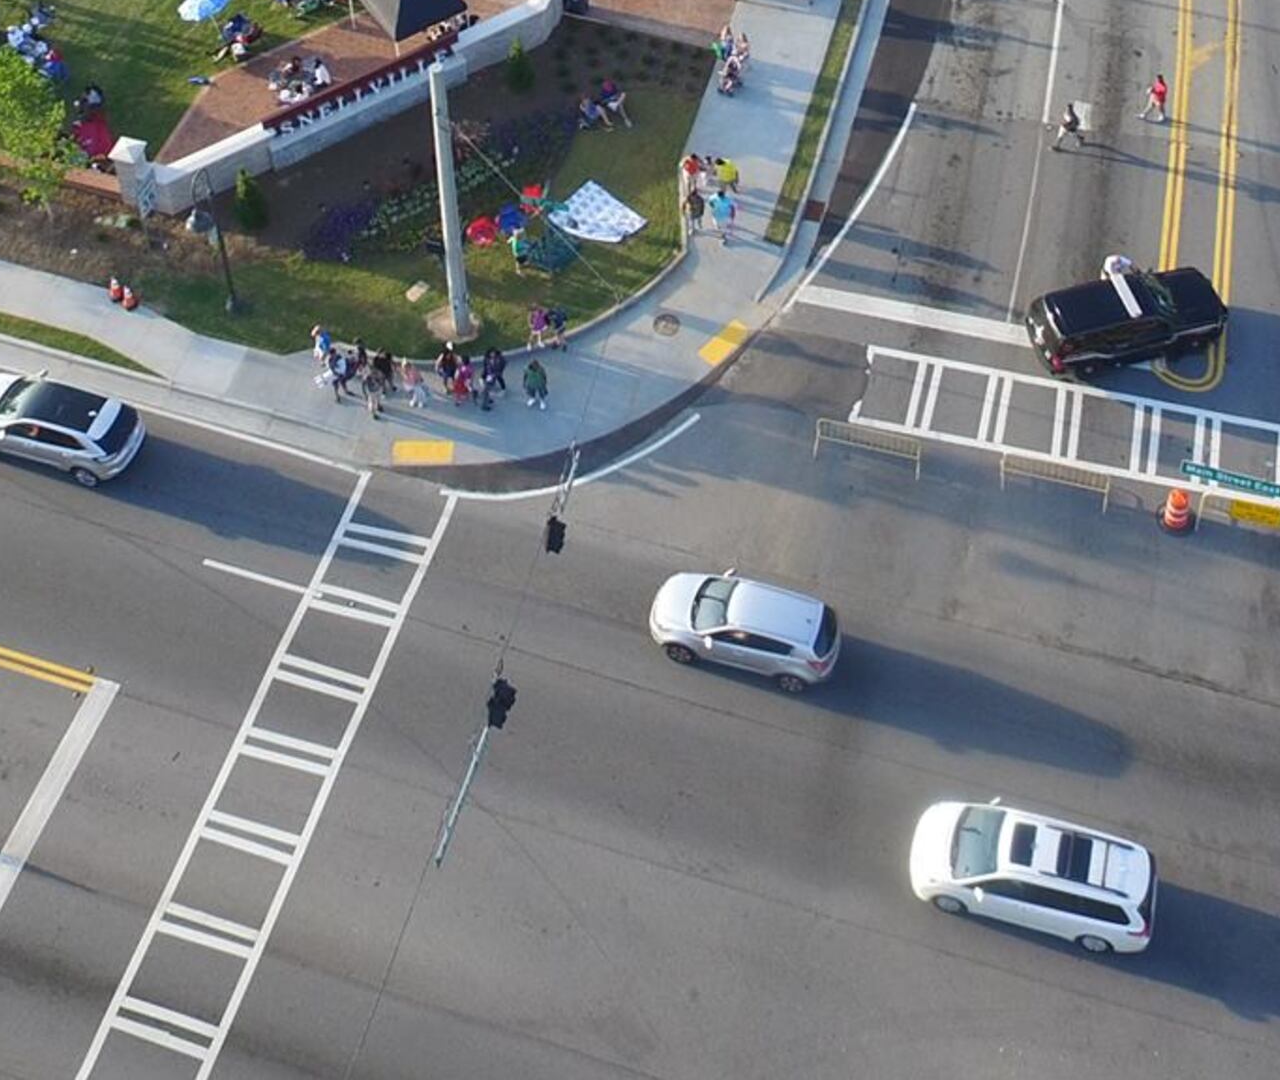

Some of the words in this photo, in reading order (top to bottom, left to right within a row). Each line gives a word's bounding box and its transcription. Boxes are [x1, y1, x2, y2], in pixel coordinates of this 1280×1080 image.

[1185, 464, 1214, 478] Main
[1216, 470, 1252, 488] Street
[1254, 481, 1280, 495] East
